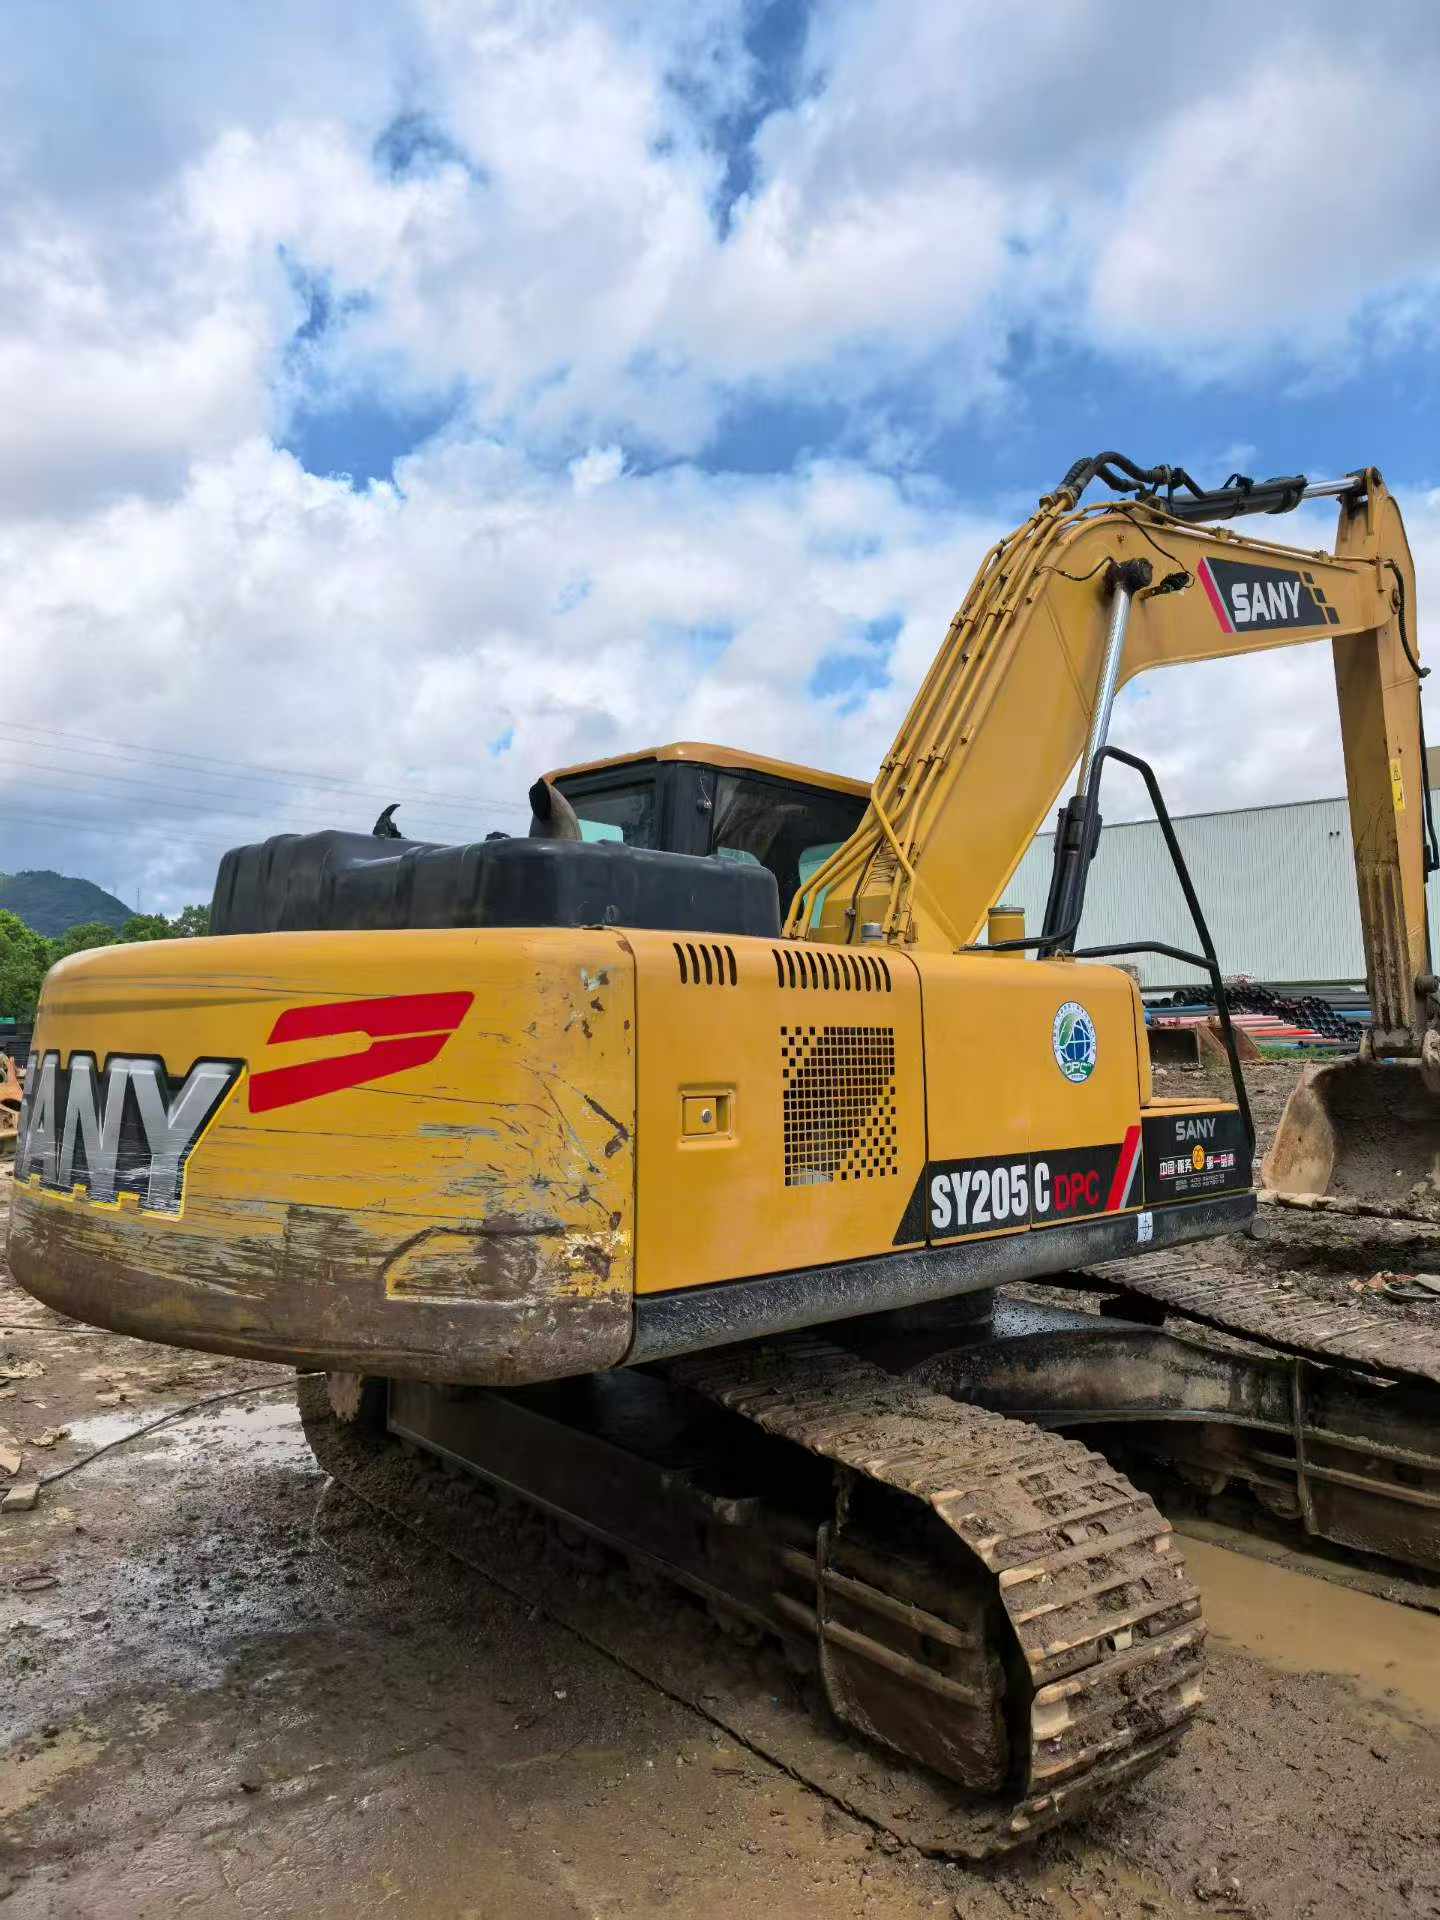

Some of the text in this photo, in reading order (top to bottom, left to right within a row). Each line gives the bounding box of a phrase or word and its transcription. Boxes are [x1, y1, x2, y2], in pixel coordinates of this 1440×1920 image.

[1231, 580, 1301, 623] SANY
[17, 1053, 234, 1209] ANY
[1175, 1118, 1216, 1141] SANY
[1055, 1171, 1099, 1211] DPC
